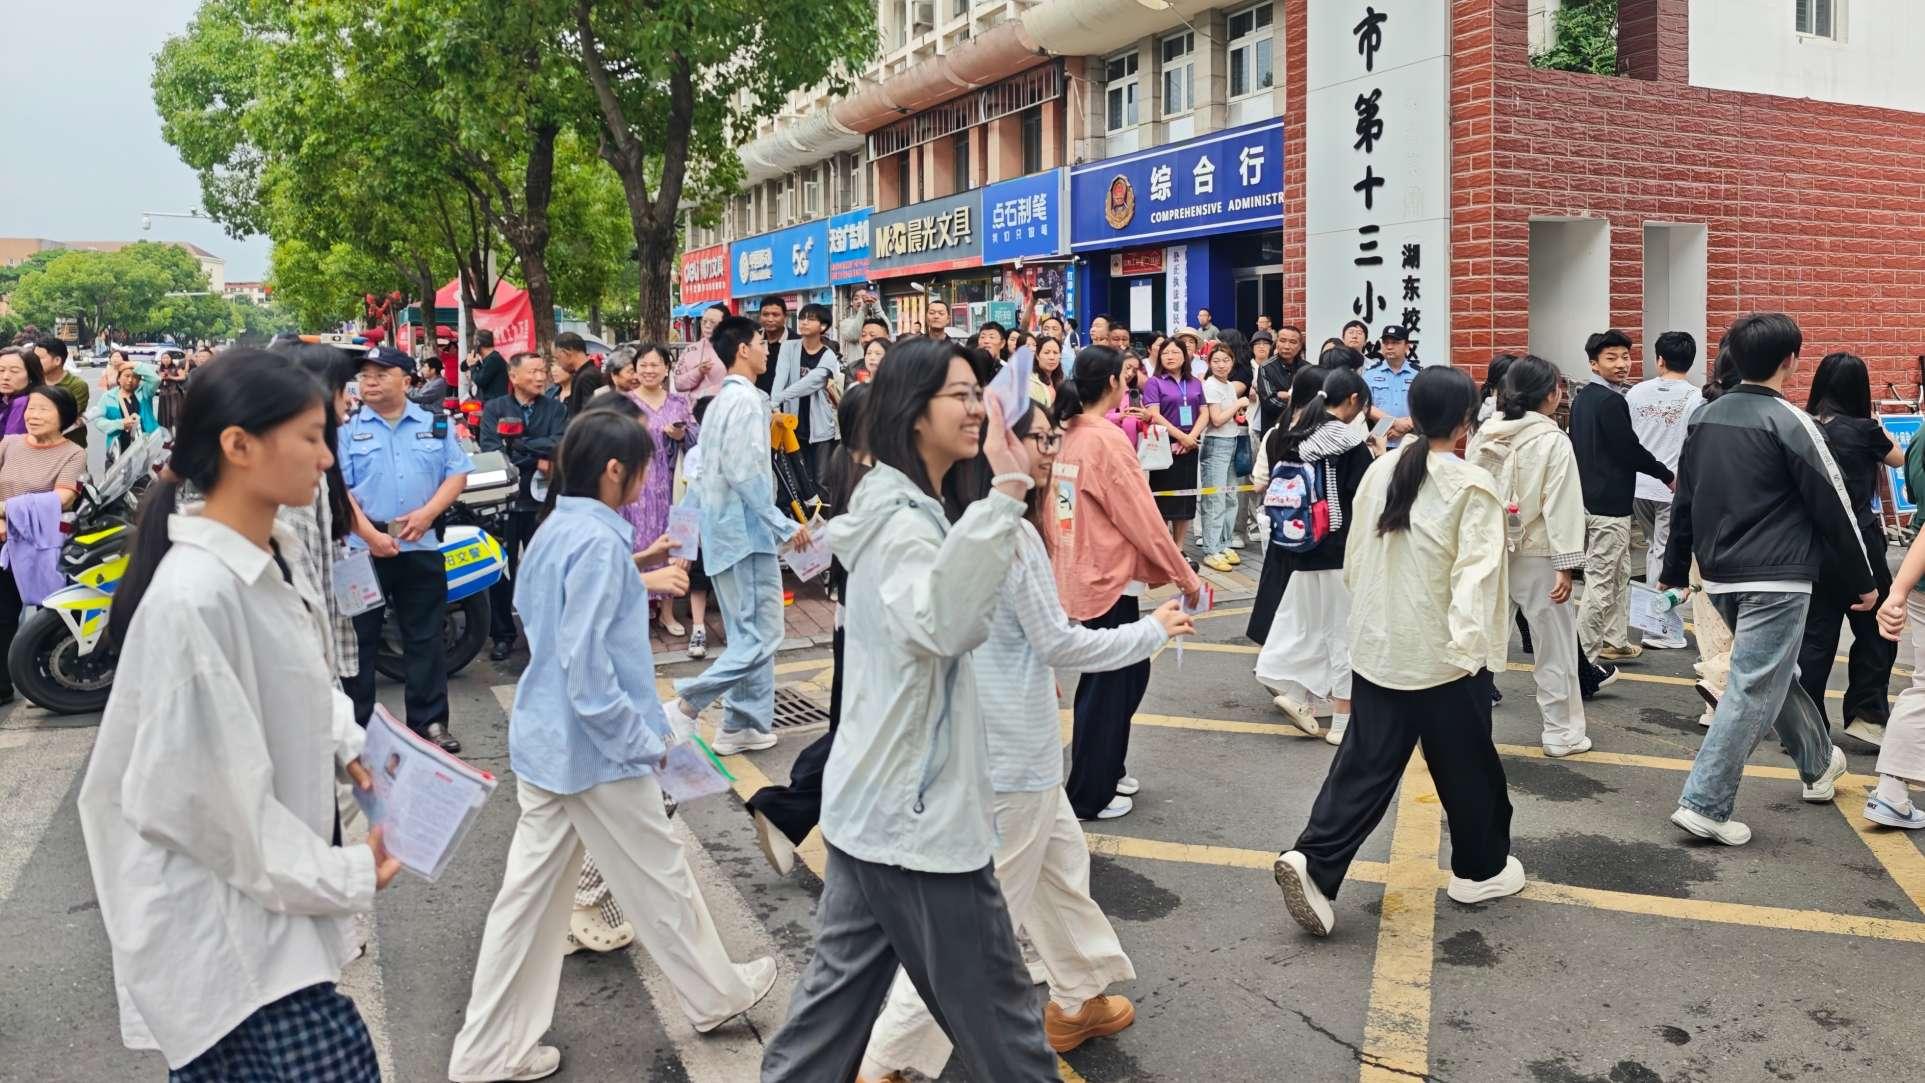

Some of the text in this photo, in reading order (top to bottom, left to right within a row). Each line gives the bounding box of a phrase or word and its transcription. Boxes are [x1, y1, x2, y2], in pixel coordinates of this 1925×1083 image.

[1150, 145, 1264, 201] 综合行
[1353, 6, 1387, 360] 市第十三小
[876, 206, 972, 258] M&G 晨光文具
[992, 193, 1047, 229] 点石制笔
[1150, 202, 1222, 223] COMPREHENSIVE
[1401, 244, 1421, 363] 湖东校区
